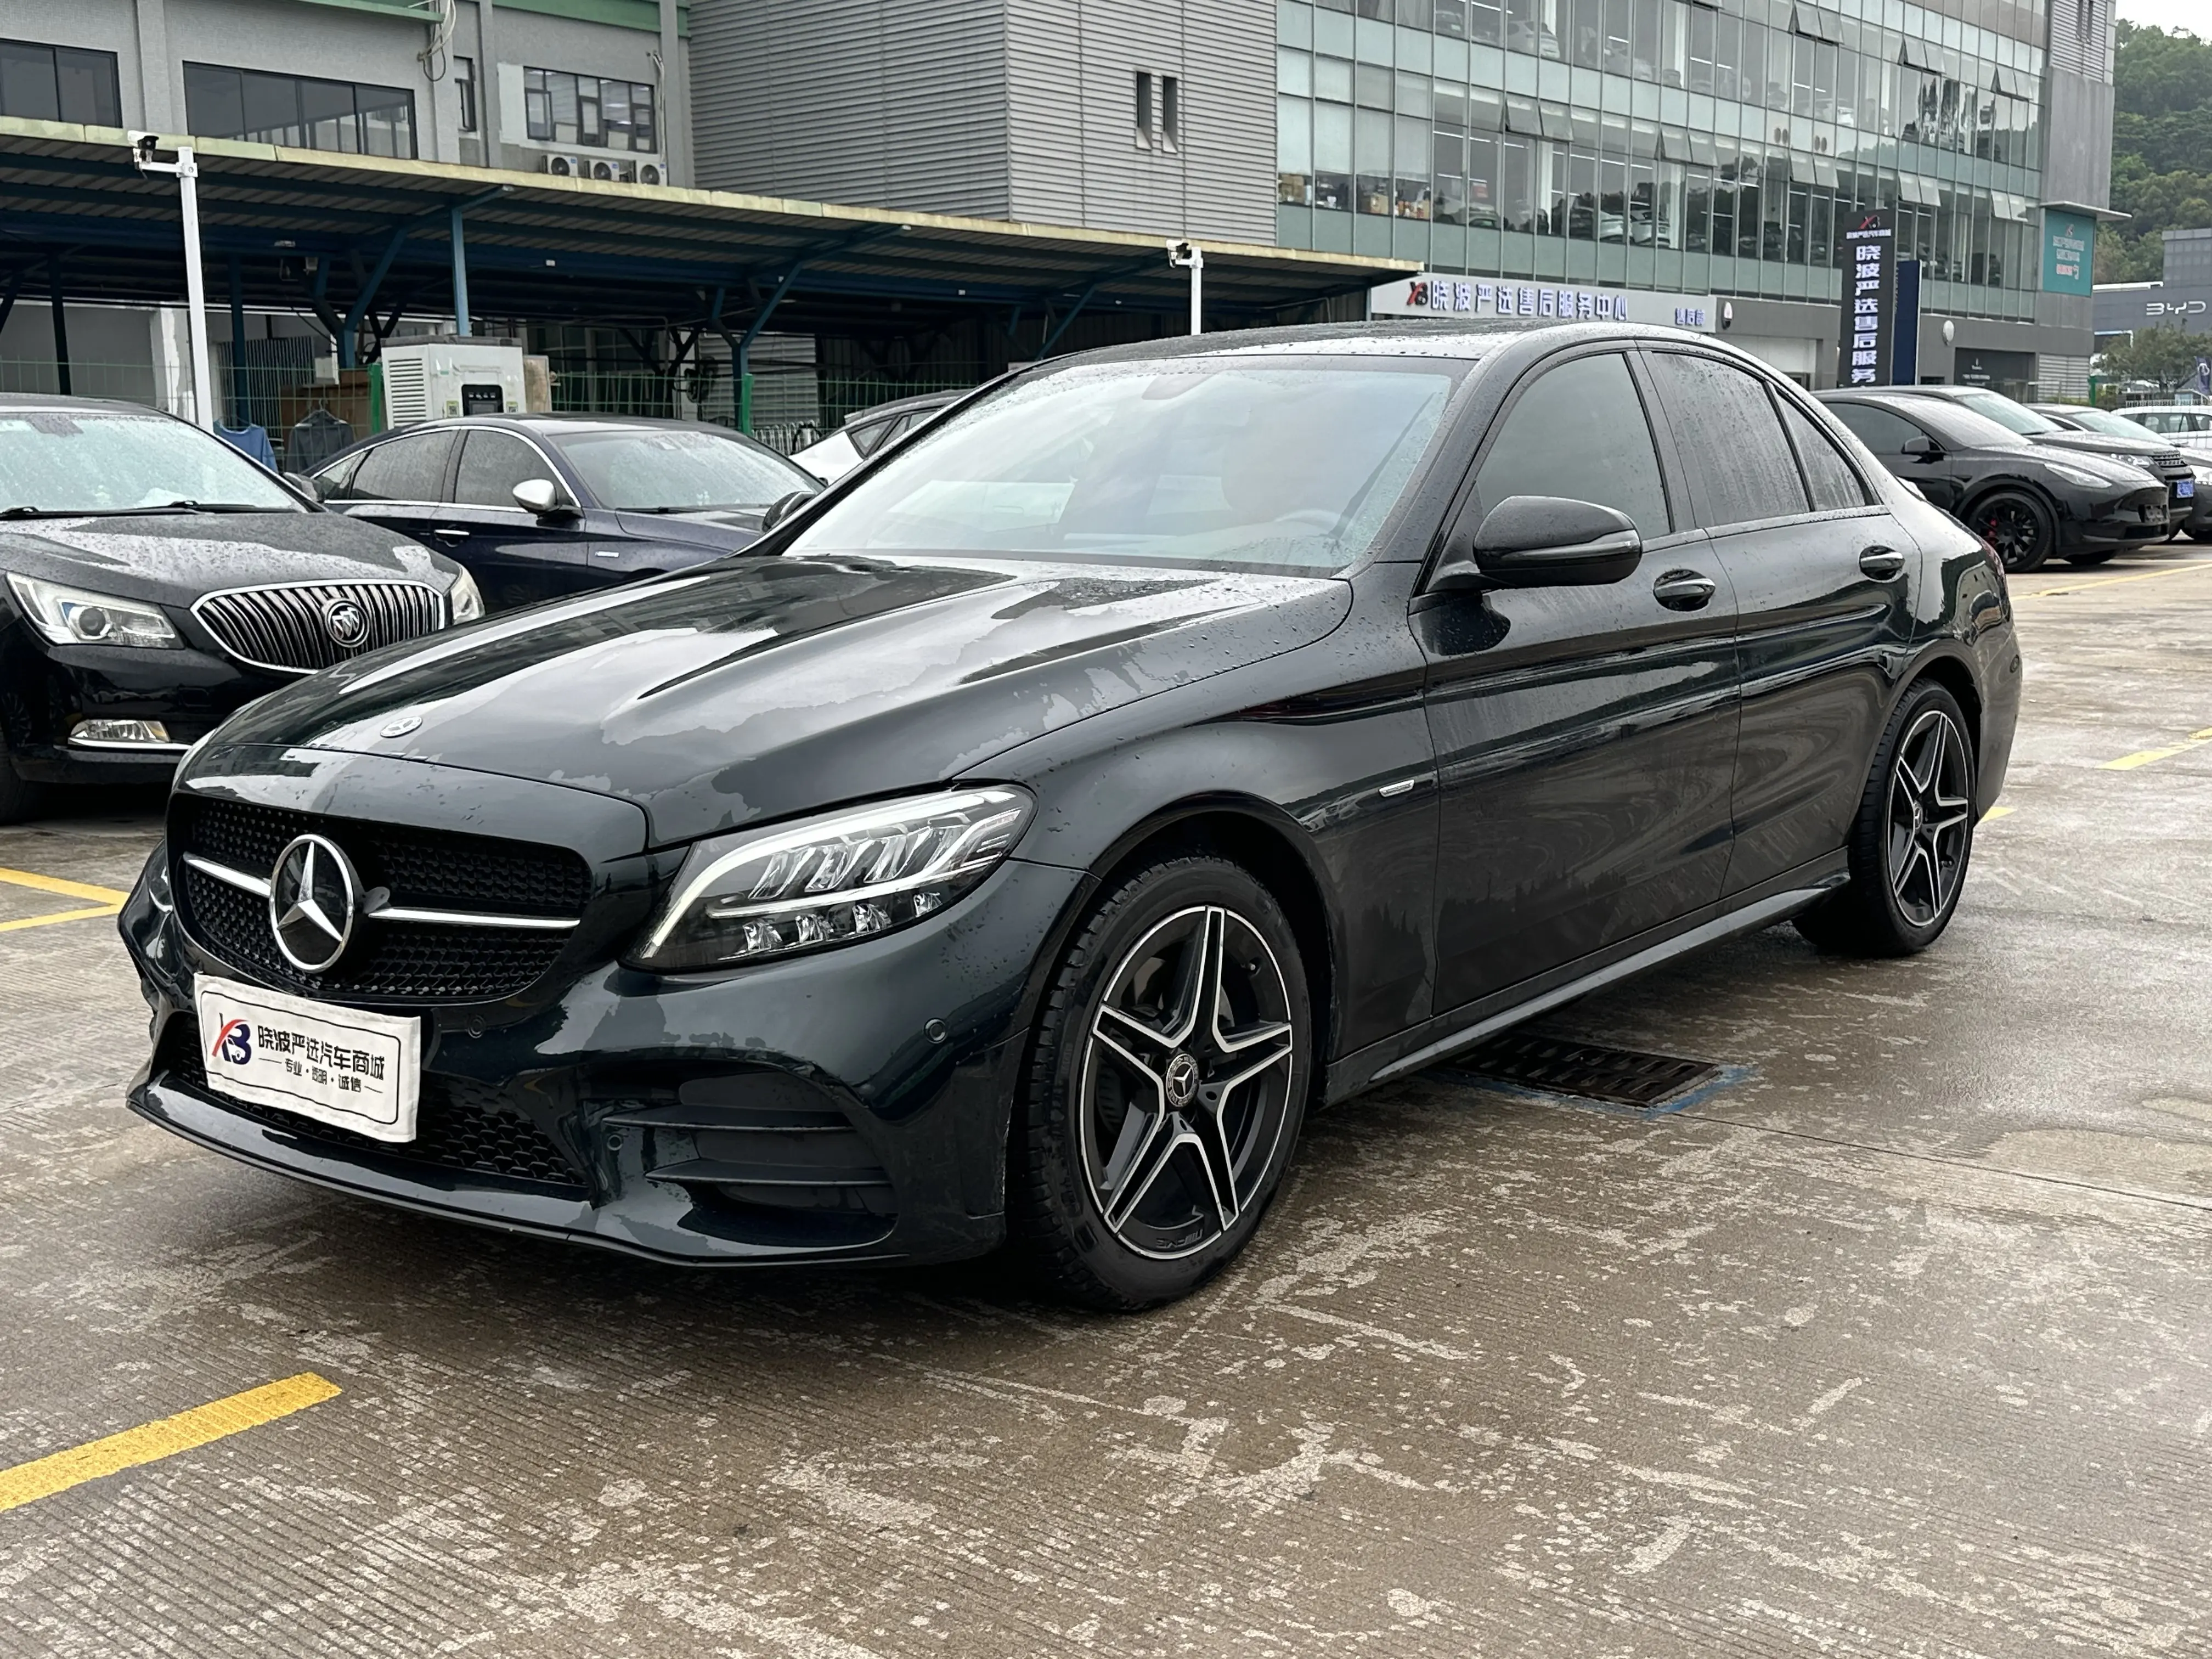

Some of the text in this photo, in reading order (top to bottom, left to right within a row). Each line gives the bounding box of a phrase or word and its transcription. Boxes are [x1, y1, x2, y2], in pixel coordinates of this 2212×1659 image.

[1431, 280, 1628, 321] 晓波严选售后服务中心
[2146, 301, 2207, 316] BYD
[257, 1024, 385, 1081] 晓波严选汽车商城
